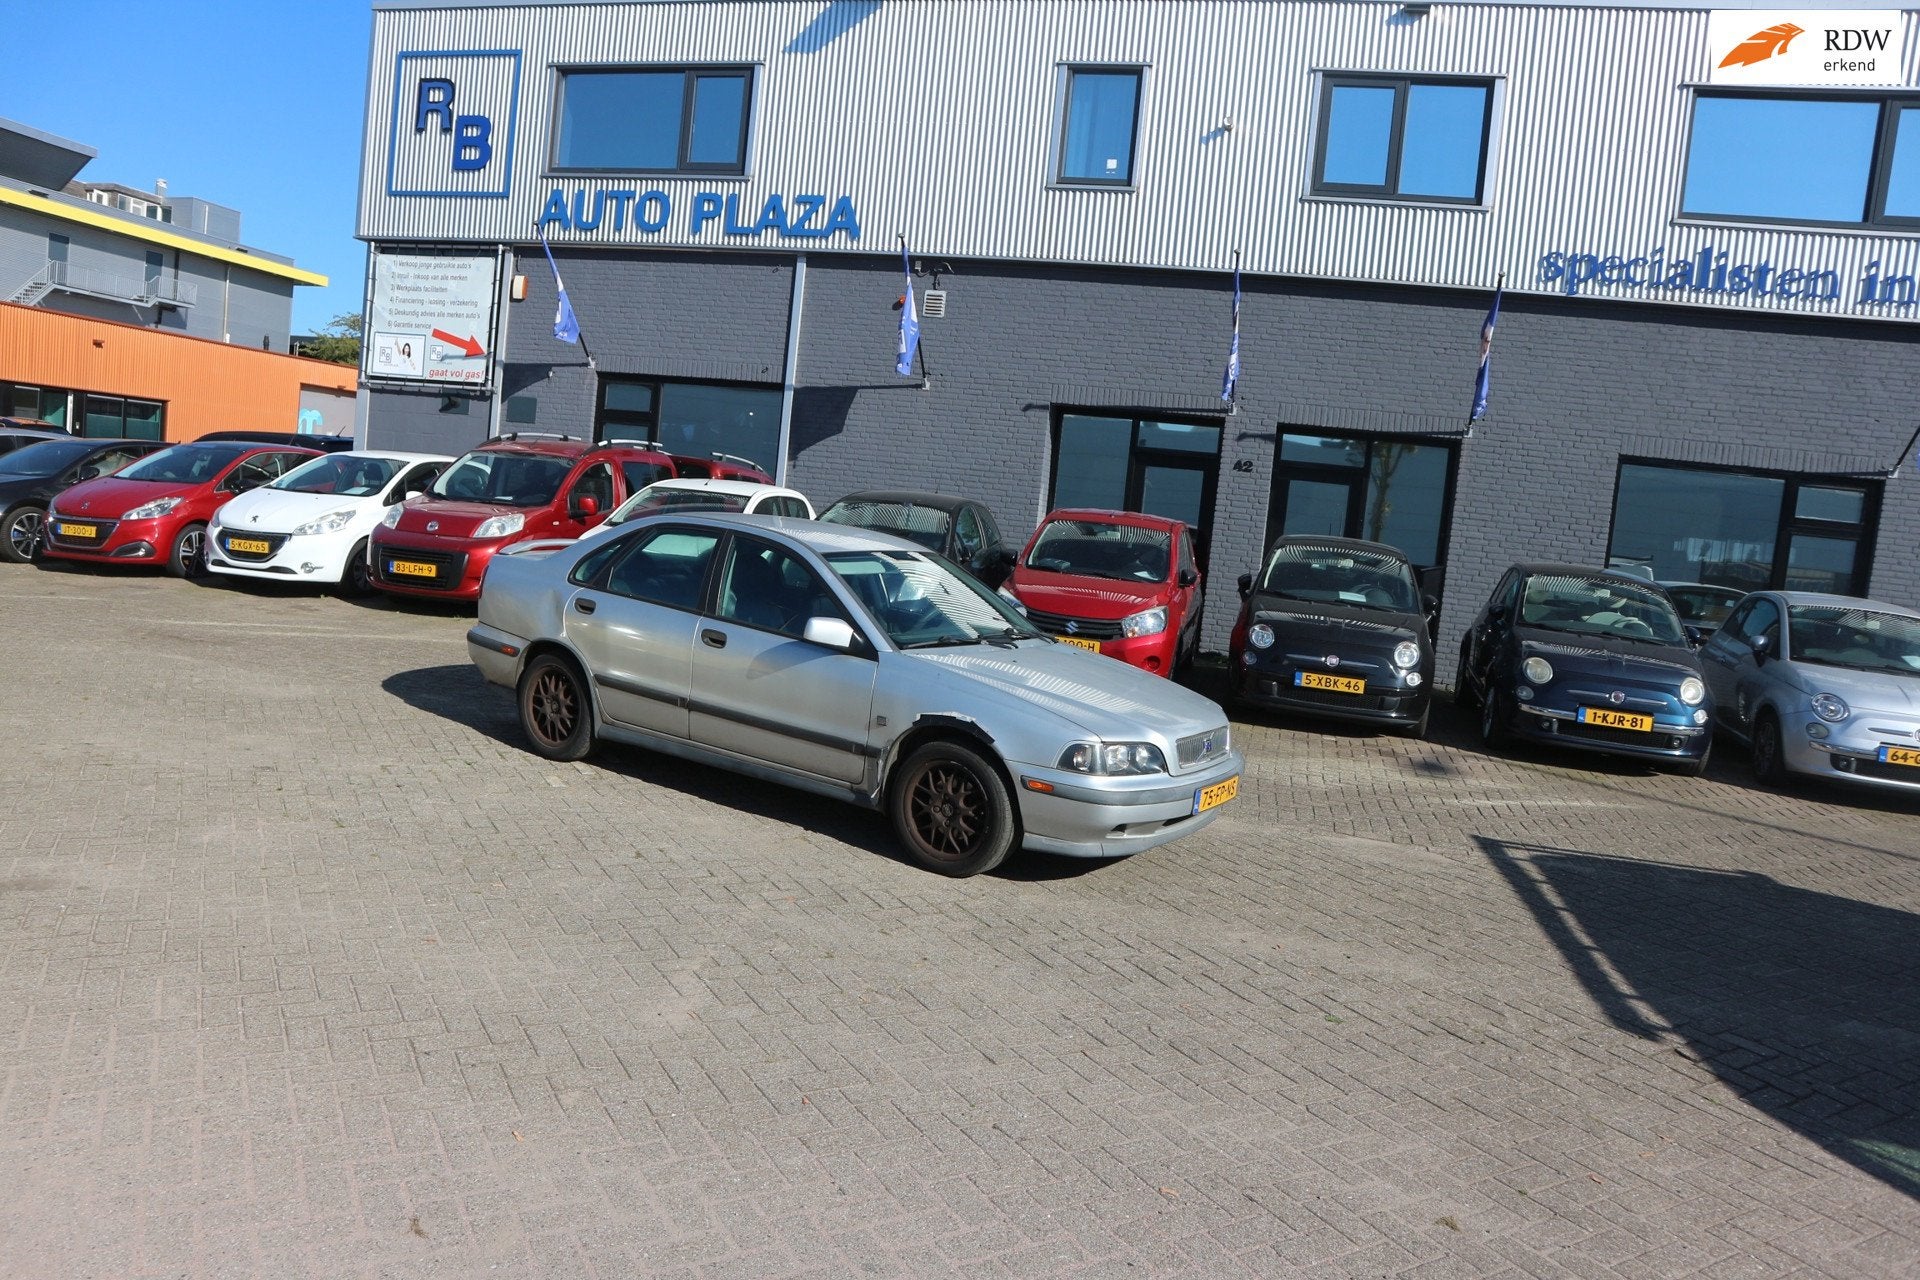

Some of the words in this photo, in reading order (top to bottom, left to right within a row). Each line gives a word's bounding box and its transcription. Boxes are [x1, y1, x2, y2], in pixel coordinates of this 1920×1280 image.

[538, 188, 671, 234] AUTO
[691, 192, 860, 241] PLAZA
[398, 260, 418, 269] Verkoop
[418, 261, 432, 270] jonge
[441, 273, 449, 281] alle
[1537, 246, 1841, 300] specialisten
[1857, 260, 1918, 307] in
[396, 284, 422, 292] Werkplaats
[423, 285, 448, 293] faciliteiten
[395, 296, 424, 306] Financiering
[450, 299, 478, 308] verzekering
[394, 308, 419, 318] Deskundig
[437, 310, 446, 318] alle
[393, 320, 413, 328] Garantie
[429, 368, 448, 378] gaat
[450, 369, 463, 377] vol
[465, 370, 484, 380] gas!
[1233, 460, 1253, 473] 42
[231, 540, 266, 552] 5-KGX-65
[396, 563, 433, 575] 83-LFH-9
[1304, 674, 1361, 692] 5-XBK-46
[1592, 711, 1644, 729] 1-KJR-81
